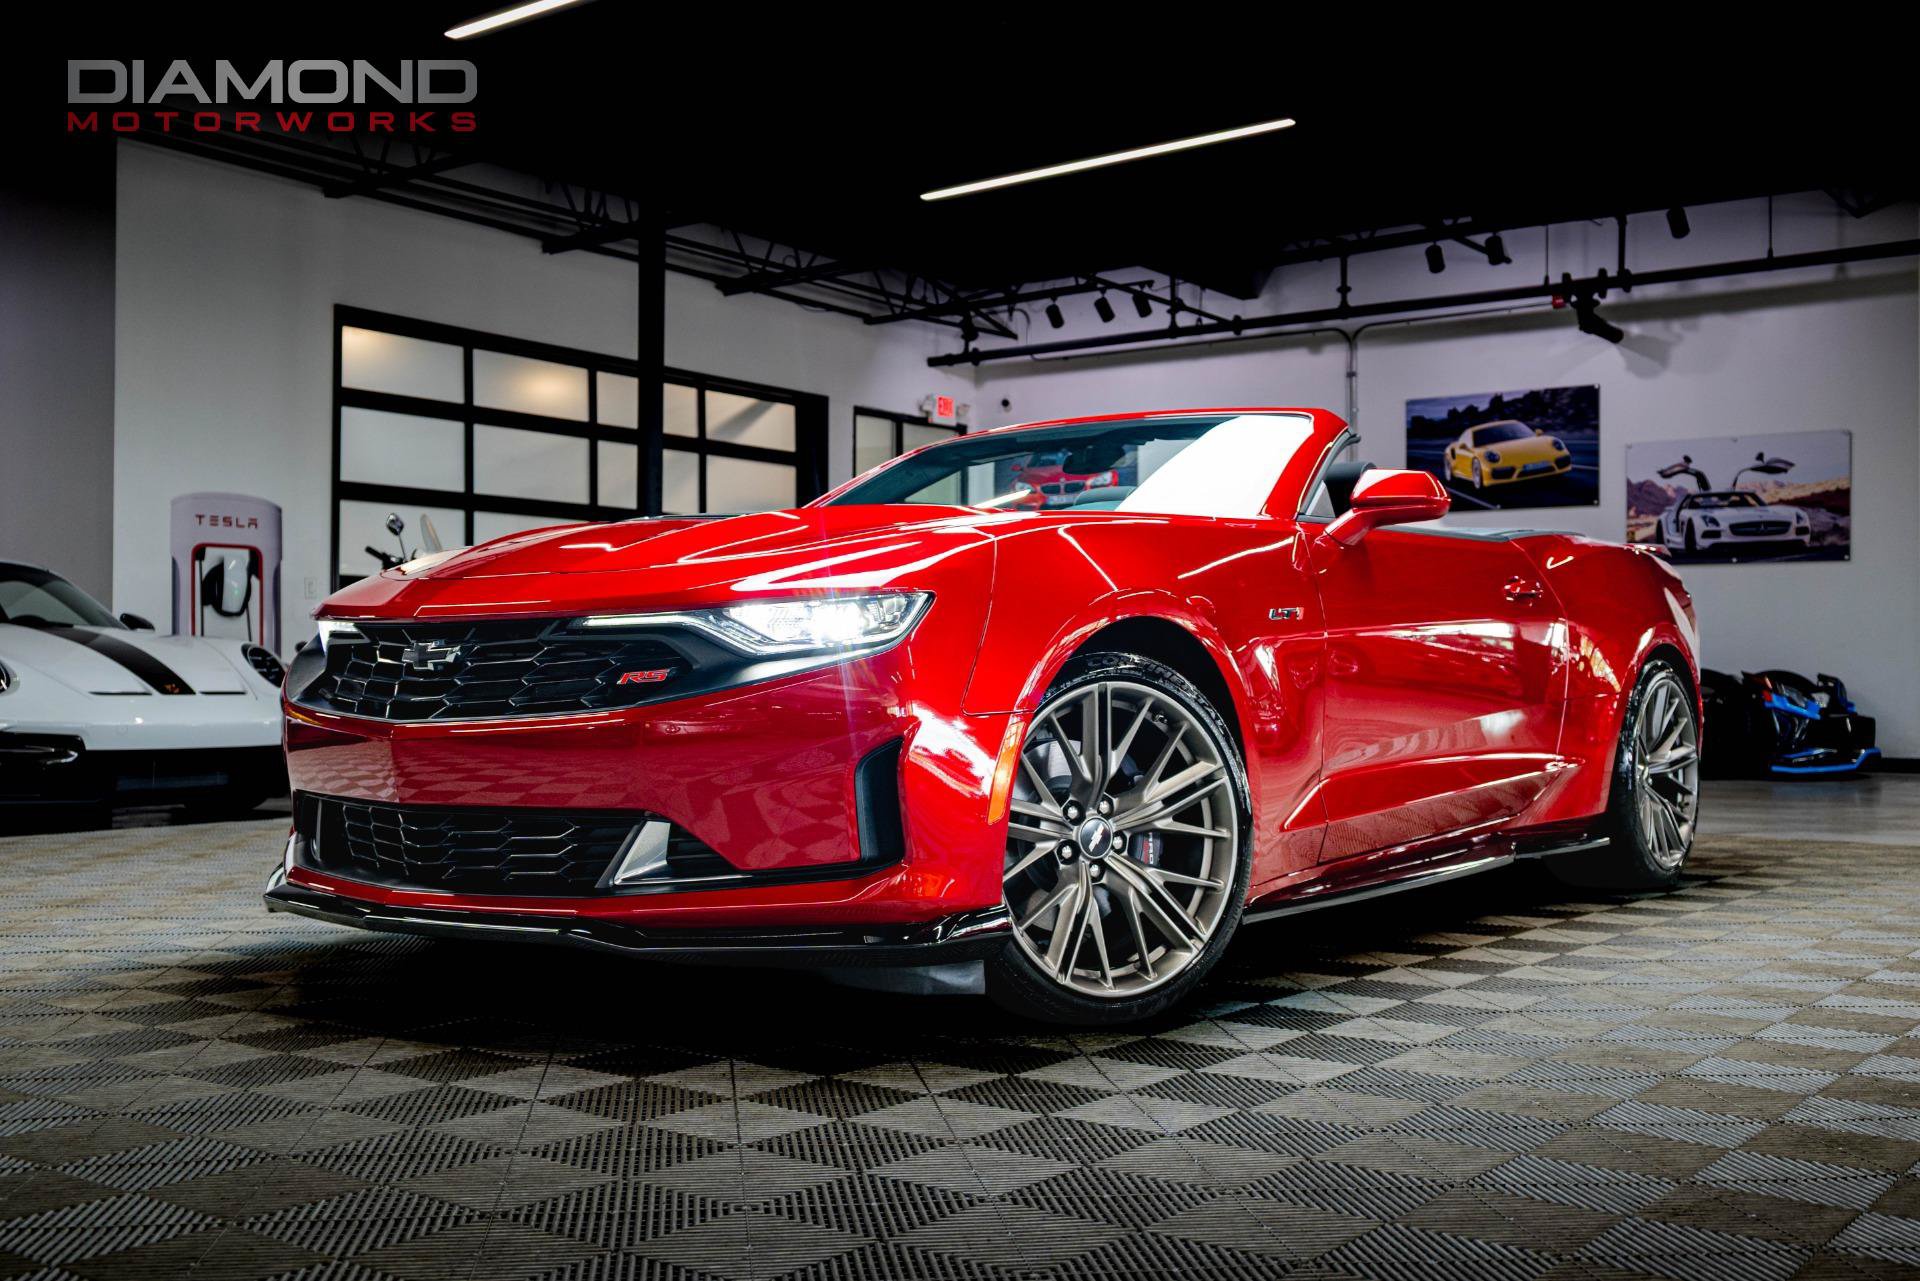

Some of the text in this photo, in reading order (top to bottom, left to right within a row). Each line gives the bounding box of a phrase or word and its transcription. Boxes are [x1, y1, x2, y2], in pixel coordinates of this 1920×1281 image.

[195, 514, 258, 529] TESLA
[1268, 607, 1304, 620] LT1
[617, 669, 670, 685] RS
